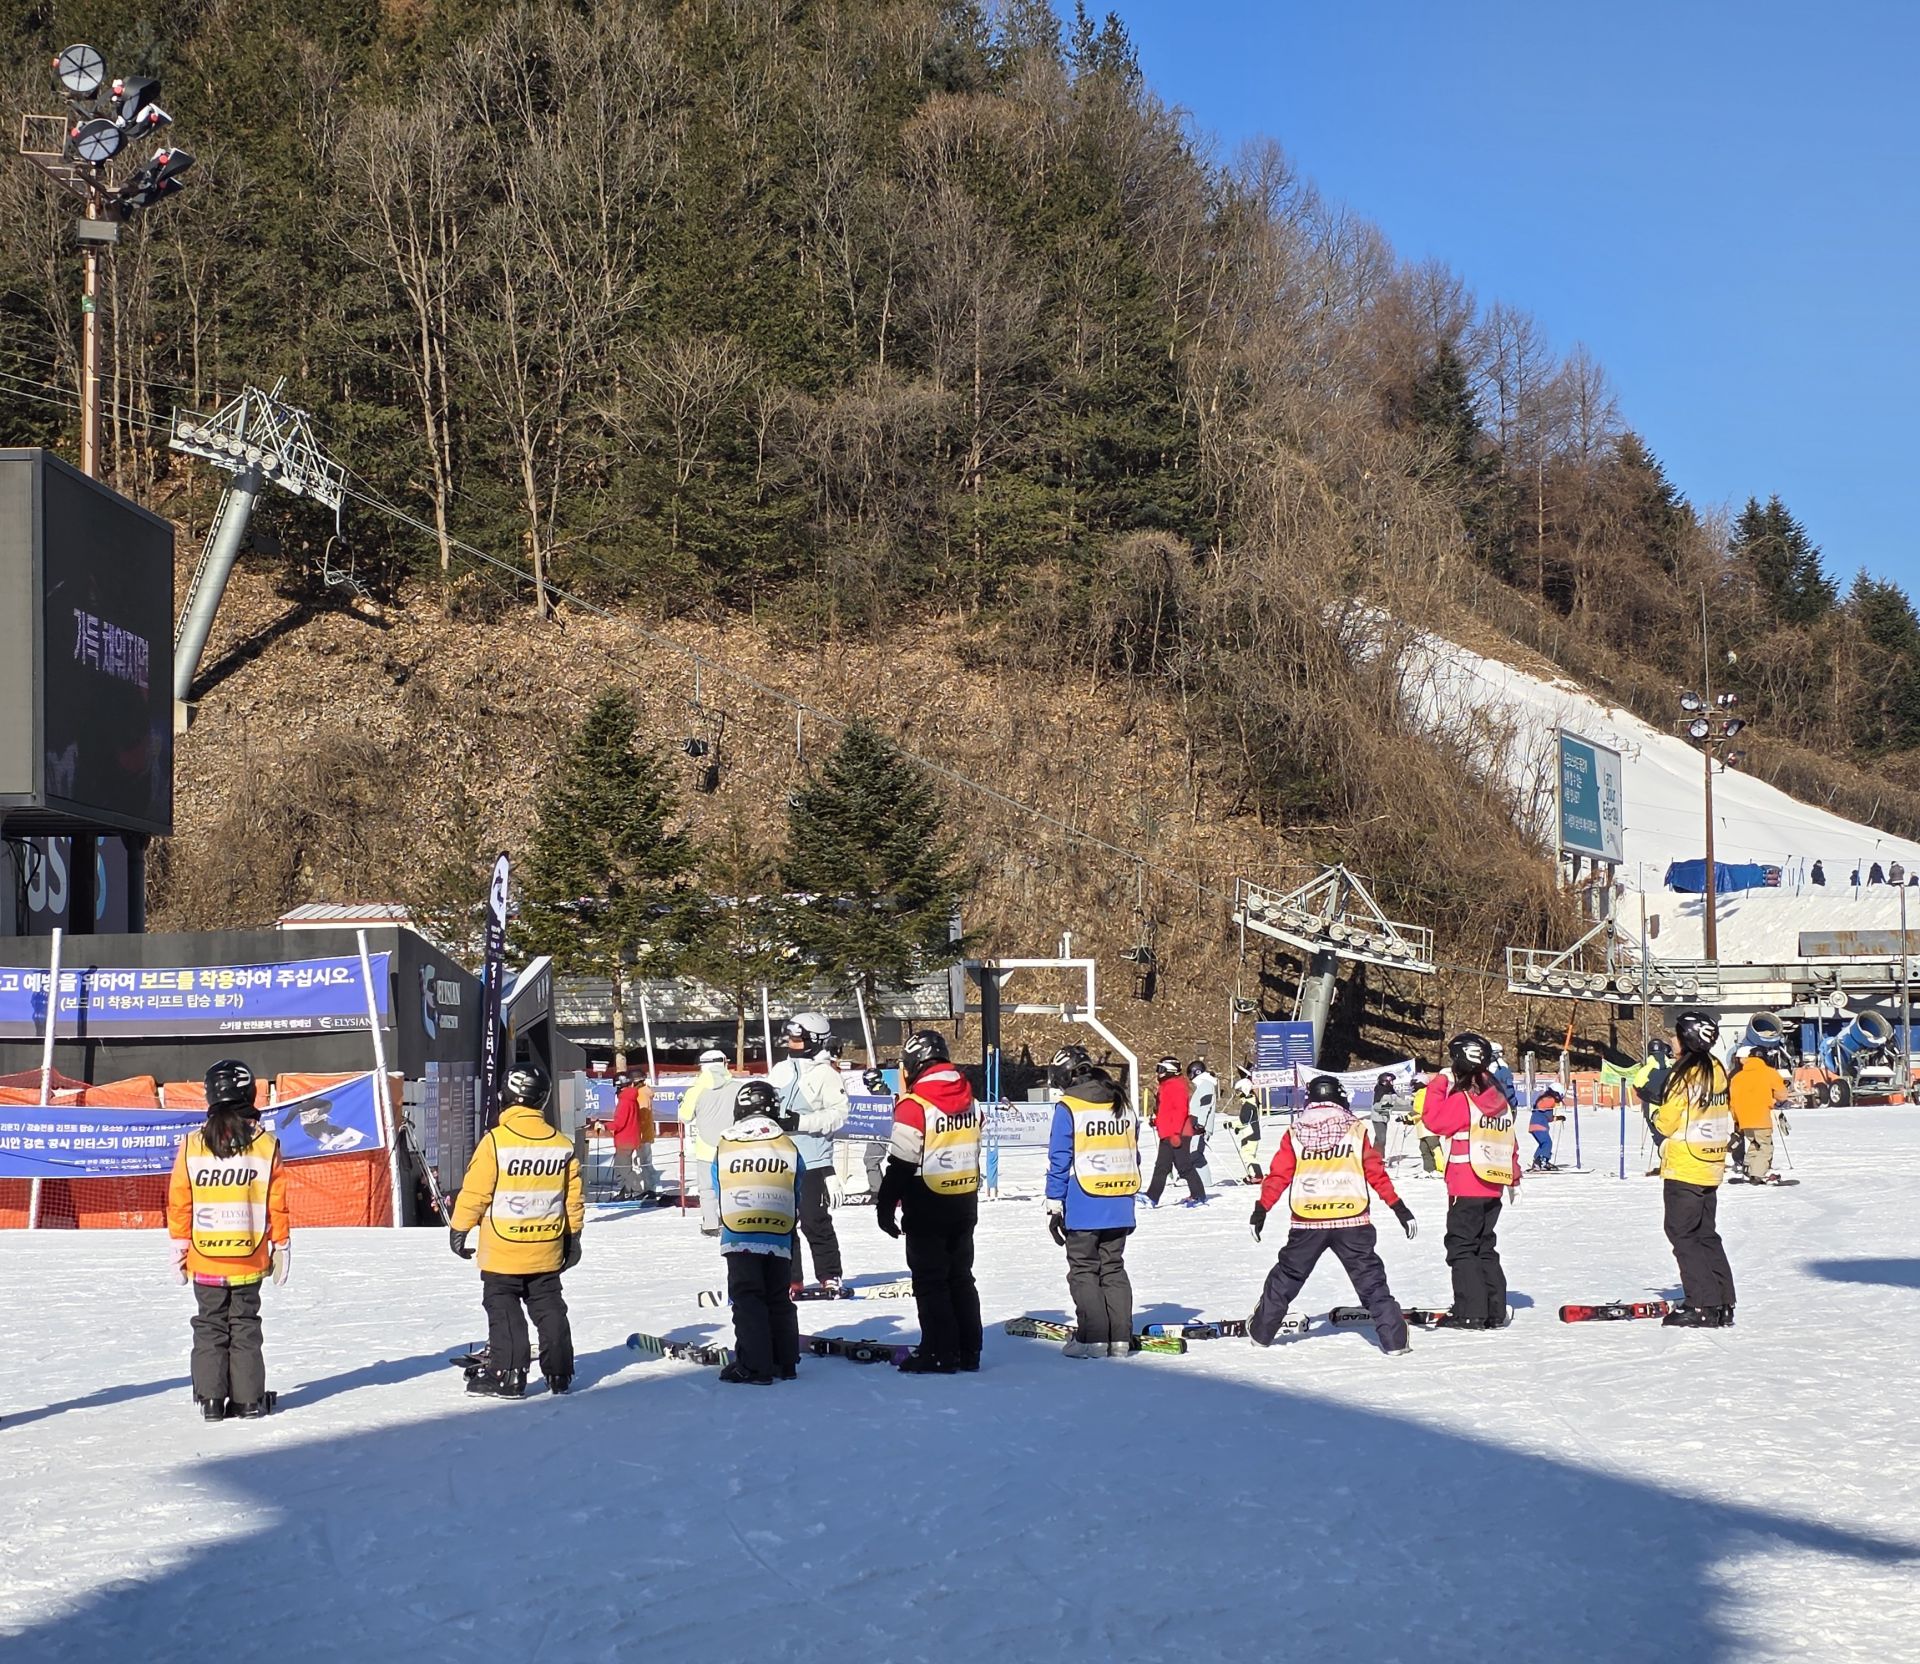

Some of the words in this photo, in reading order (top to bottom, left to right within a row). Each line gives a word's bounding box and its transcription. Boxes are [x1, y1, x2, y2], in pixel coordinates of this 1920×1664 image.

[0, 974, 19, 992] 고
[82, 972, 136, 992] 위하여
[139, 970, 195, 991] 보드를
[199, 968, 272, 990] 착용하여
[276, 967, 355, 989] 주십시오.
[93, 997, 104, 1011] 미
[108, 995, 144, 1010] 착용자
[147, 995, 184, 1009] 리프트
[188, 994, 212, 1009] 탑승
[214, 993, 244, 1010] 불가)
[334, 1018, 373, 1027] ELYSIAN
[1085, 1119, 1131, 1138] GROUP
[73, 1136, 119, 1151] 인터스키
[121, 1135, 171, 1150] 아카데미,
[507, 1158, 566, 1177] GROUP
[729, 1157, 789, 1174] GROUP
[195, 1167, 259, 1188] GROUP
[941, 1176, 978, 1188] SKITZ
[1303, 1202, 1355, 1211] SKITZO
[509, 1223, 560, 1234] SKITZO
[199, 1238, 253, 1249] SKITZO
